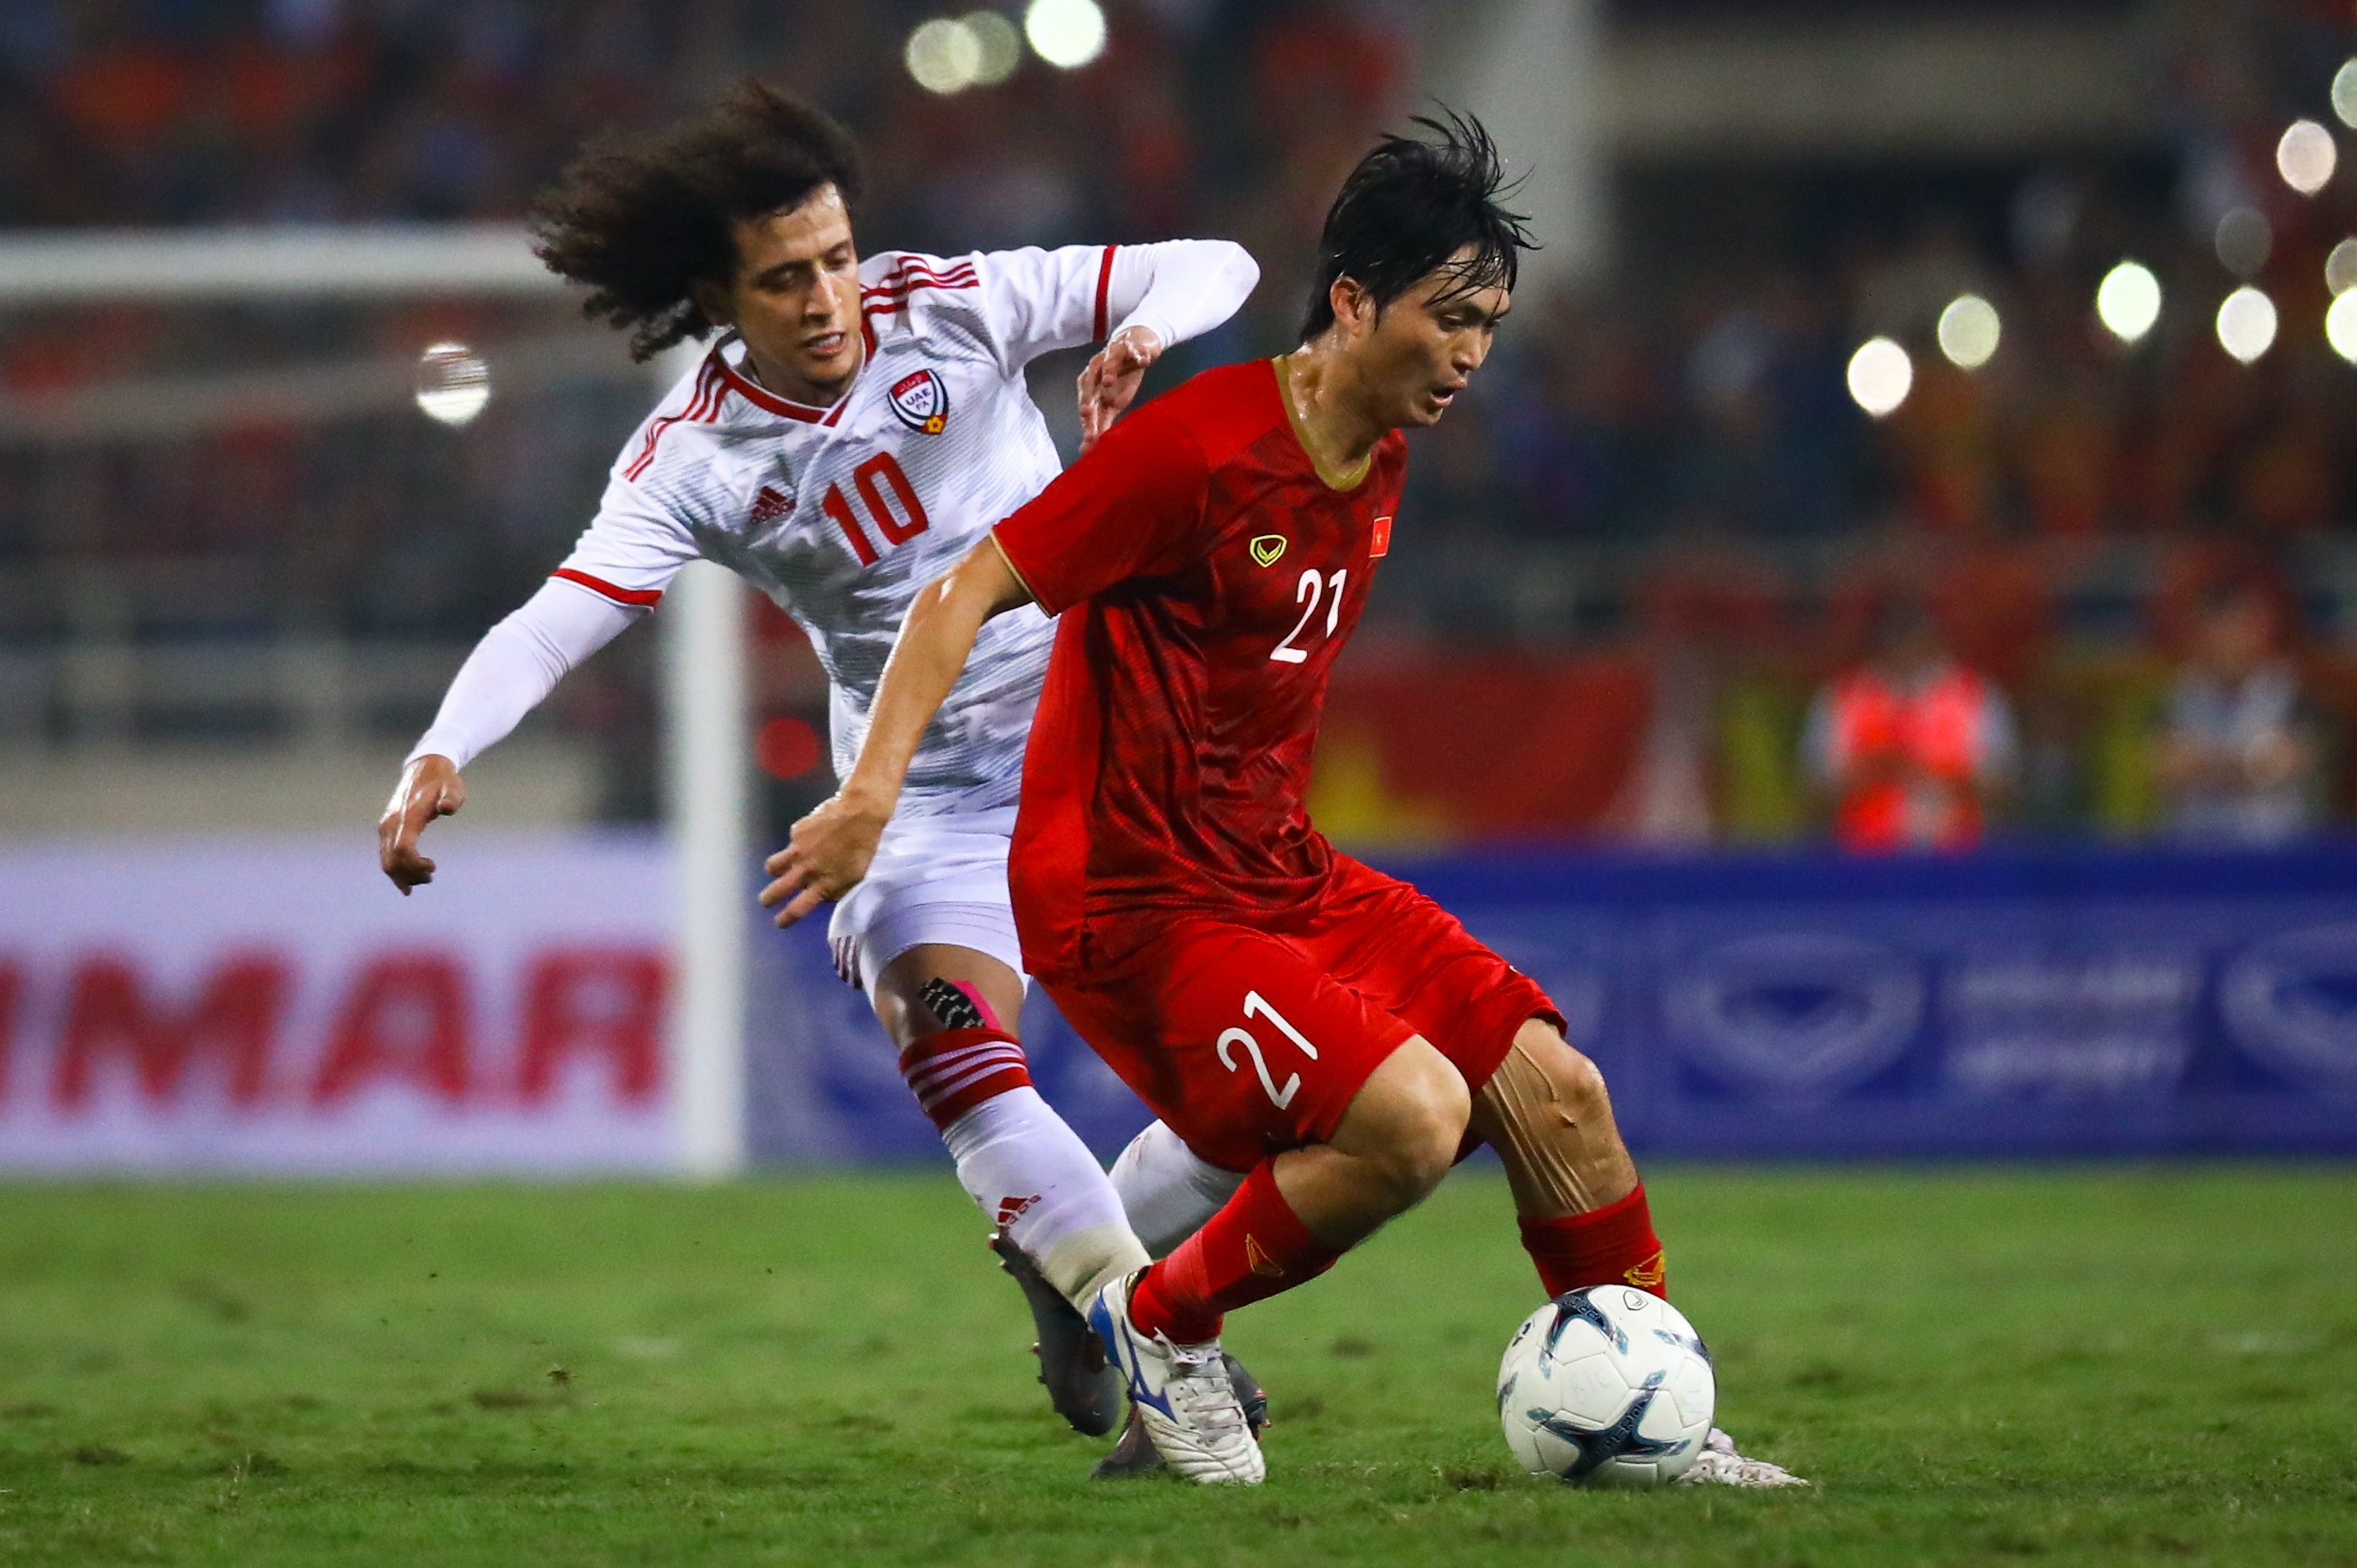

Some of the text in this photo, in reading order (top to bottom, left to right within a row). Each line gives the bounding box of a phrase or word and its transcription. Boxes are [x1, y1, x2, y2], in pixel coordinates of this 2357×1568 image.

[906, 388, 931, 405] UAE
[821, 451, 930, 567] 10
[1269, 568, 1349, 664] 21
[1216, 989, 1319, 1112] 21
